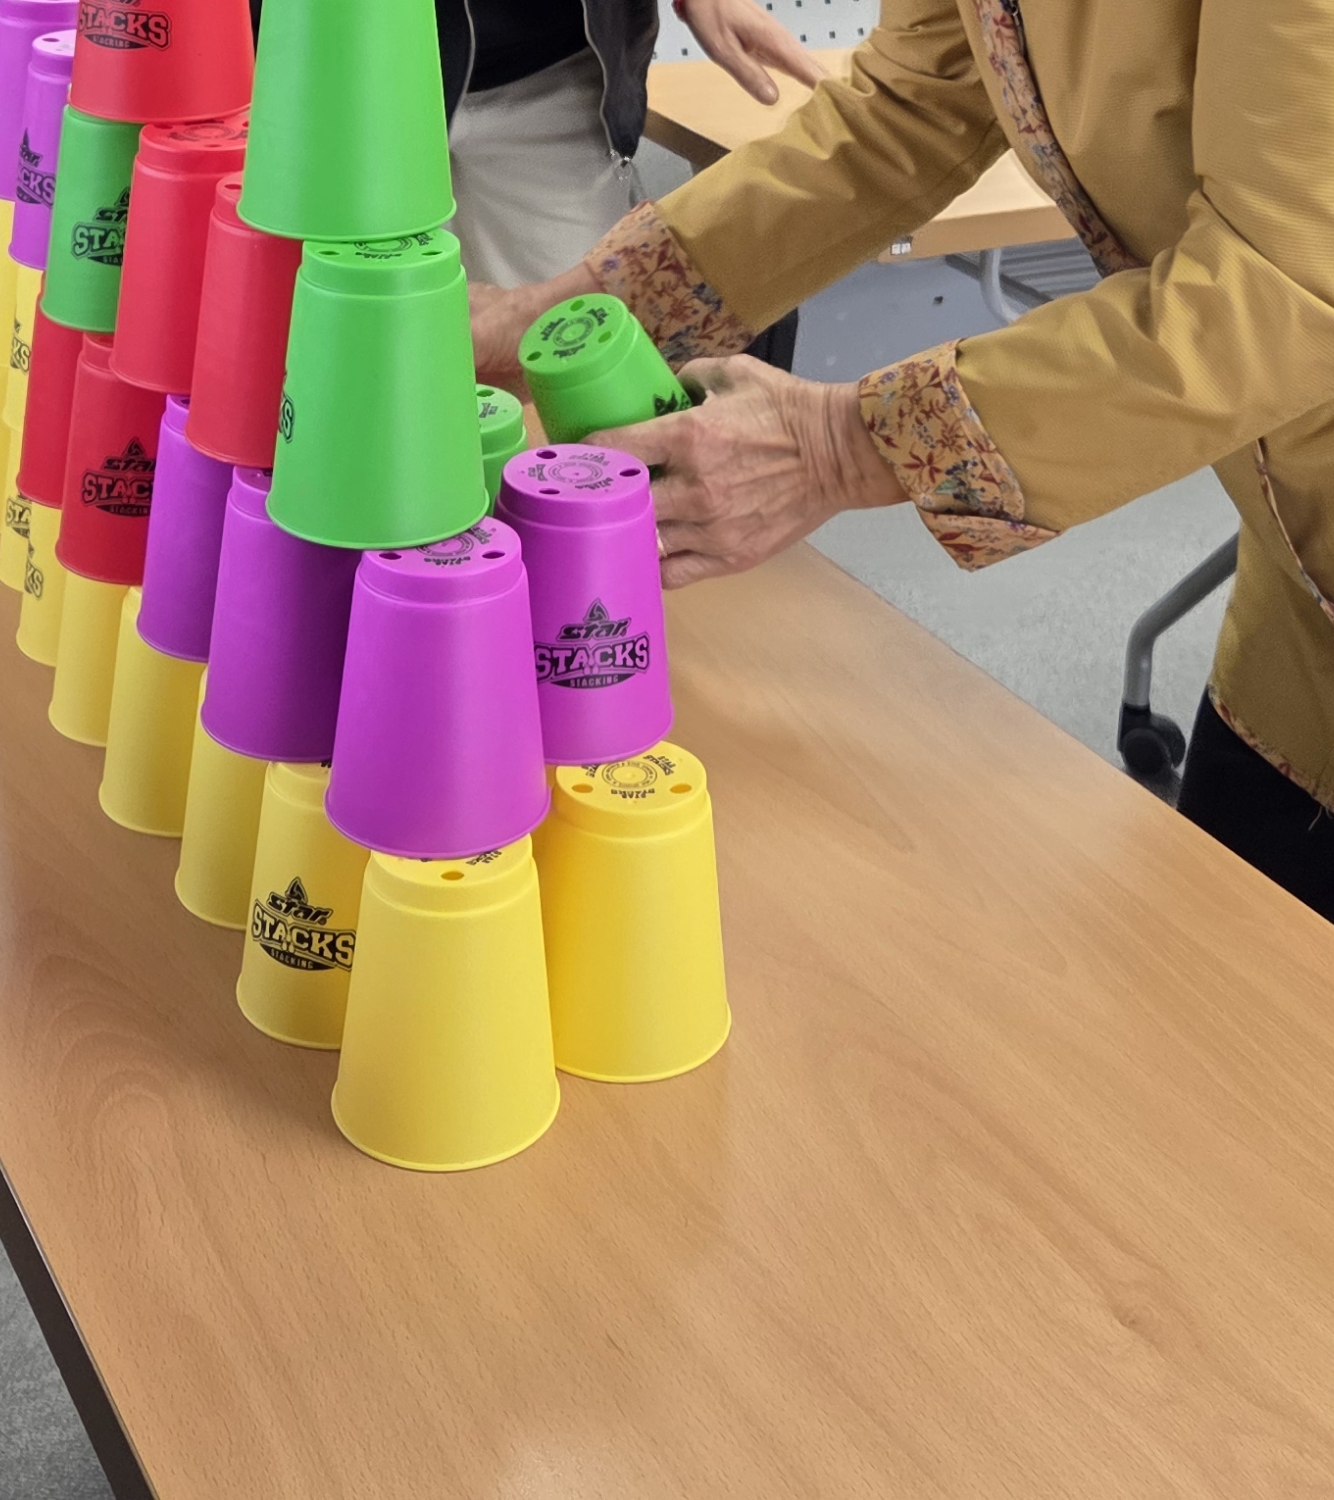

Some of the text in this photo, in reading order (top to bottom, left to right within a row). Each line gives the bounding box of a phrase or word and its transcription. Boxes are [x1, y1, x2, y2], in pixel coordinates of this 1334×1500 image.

[78, 0, 172, 51] STACKS
[71, 221, 127, 260] STA
[82, 469, 153, 507] STAC
[534, 631, 650, 684] STACKS
[570, 674, 619, 687] STACKING
[252, 899, 356, 972] STACKS
[271, 948, 314, 969] STACKING
